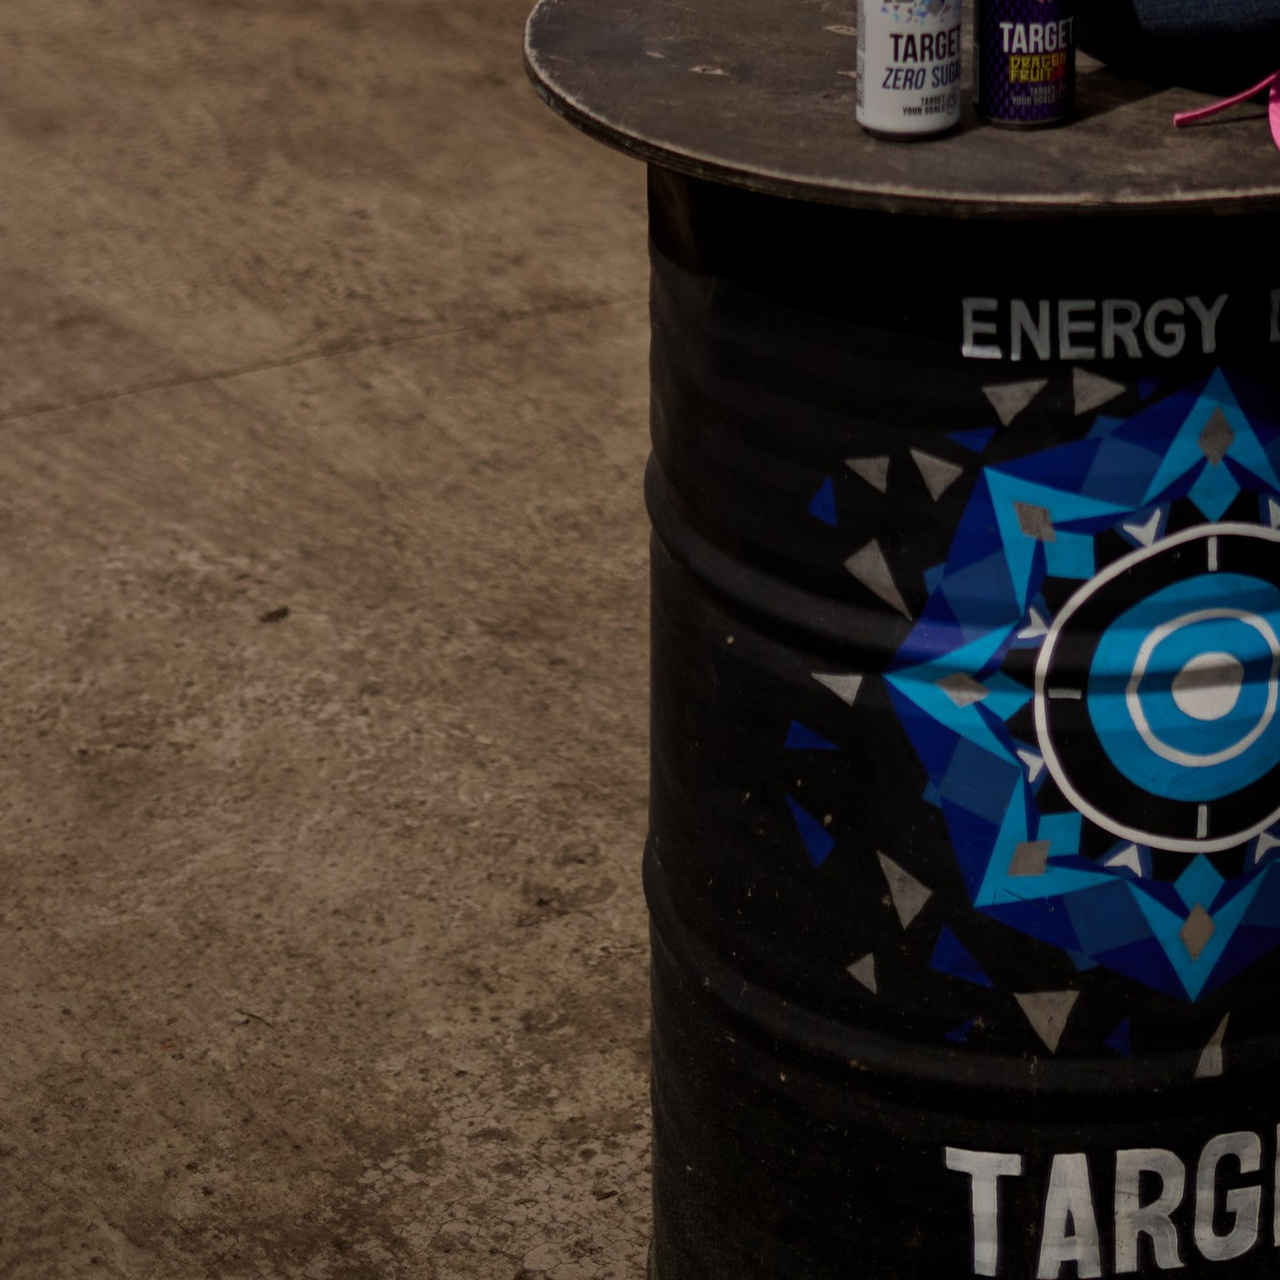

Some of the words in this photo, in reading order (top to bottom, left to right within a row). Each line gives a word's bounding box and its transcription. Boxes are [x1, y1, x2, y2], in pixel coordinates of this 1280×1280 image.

[999, 16, 1074, 53] TARGET
[881, 67, 926, 91] ZERO
[1009, 68, 1052, 84] FRUIT
[921, 95, 945, 107] TARGET
[1013, 95, 1032, 107] YOUR
[903, 106, 922, 116] YOUR
[960, 293, 1229, 361] ENERGY
